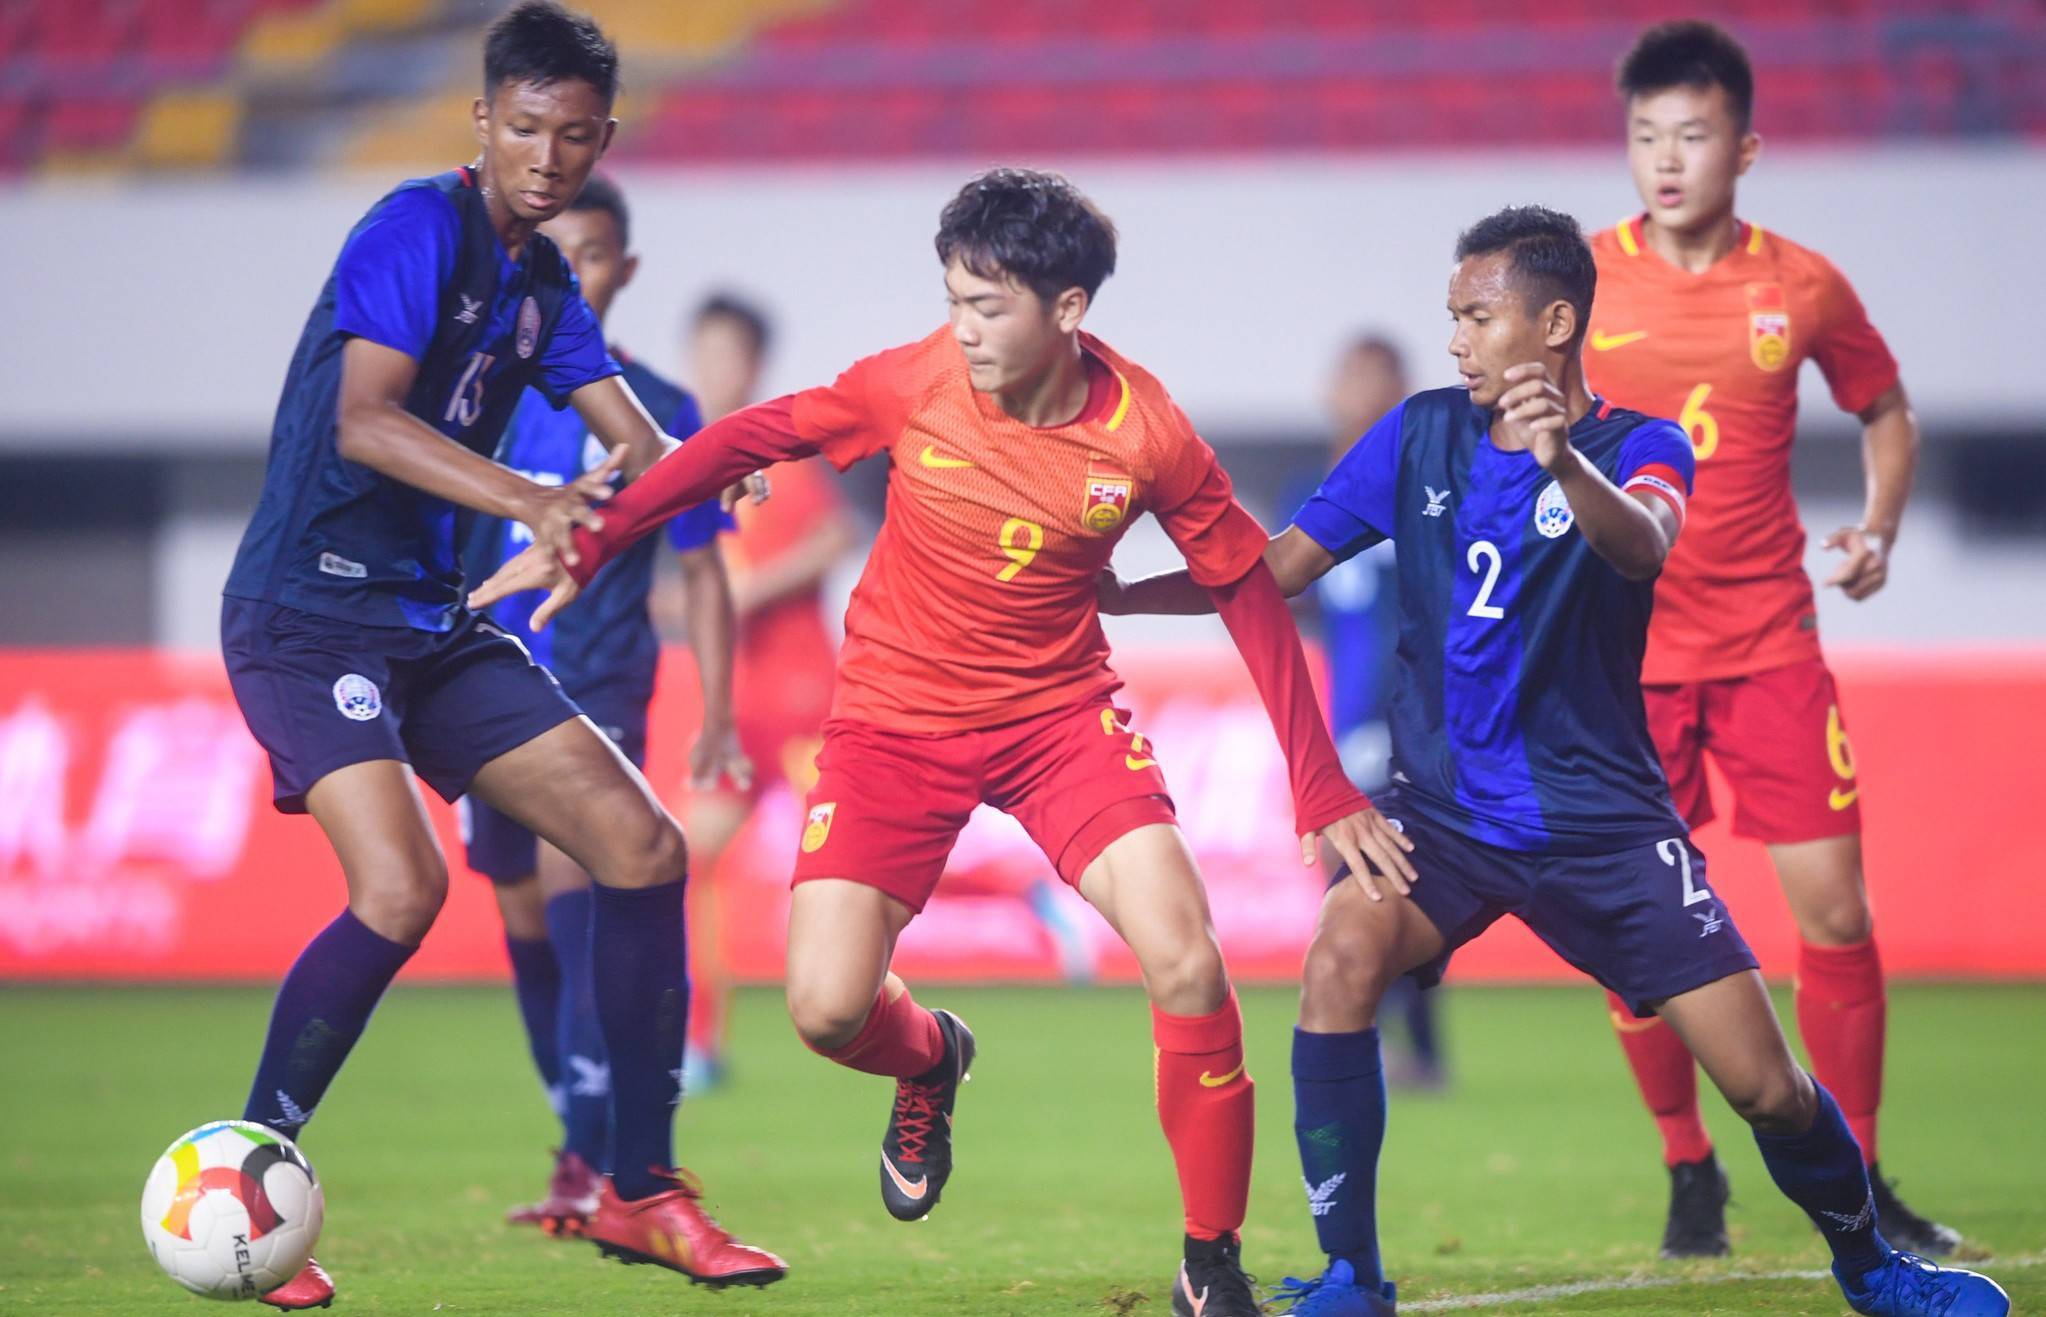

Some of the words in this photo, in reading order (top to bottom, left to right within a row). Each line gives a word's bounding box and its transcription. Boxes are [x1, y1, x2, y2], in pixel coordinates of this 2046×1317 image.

[1680, 383, 1719, 460] 6
[995, 517, 1043, 582] 9
[1466, 540, 1504, 620] 2
[1826, 705, 1855, 779] 6
[1656, 838, 1711, 907] 2
